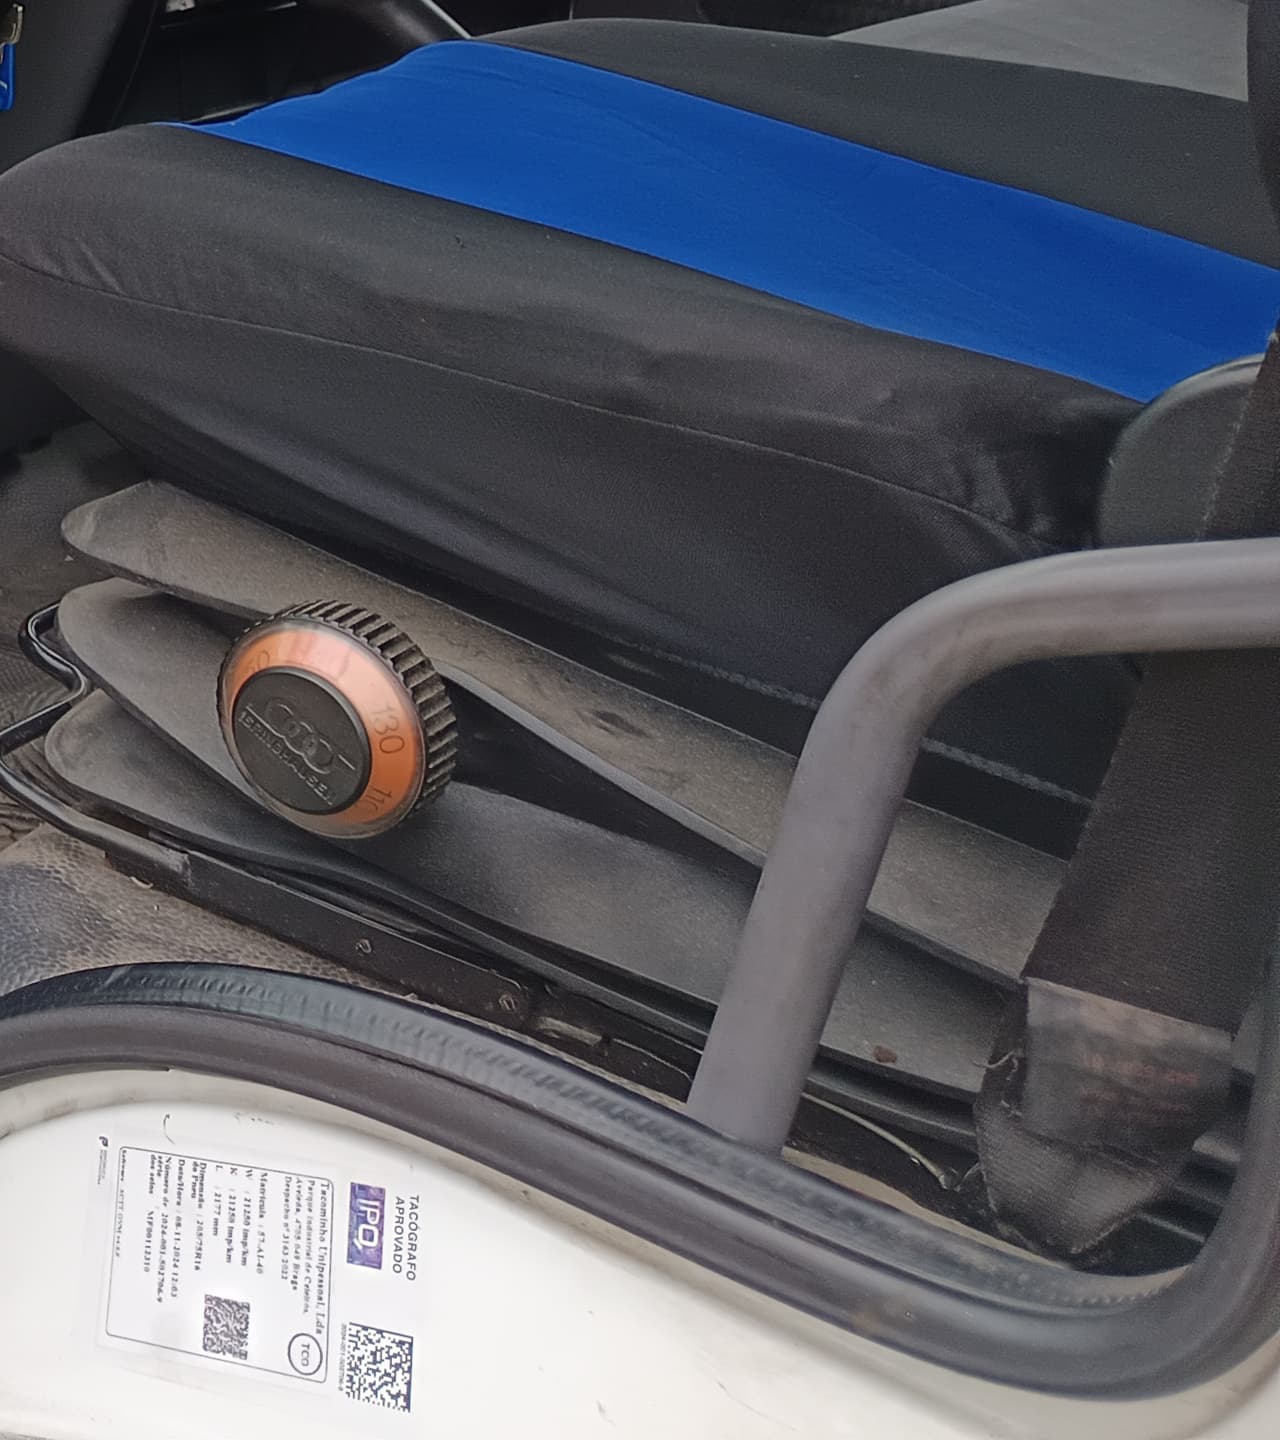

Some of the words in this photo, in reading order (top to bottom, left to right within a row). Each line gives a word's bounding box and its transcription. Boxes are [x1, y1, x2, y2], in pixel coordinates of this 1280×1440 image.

[370, 702, 406, 754] 130
[353, 1199, 380, 1250] IPQ
[392, 1197, 404, 1274] APROVADO
[406, 1195, 421, 1281] TACÓGRAFO
